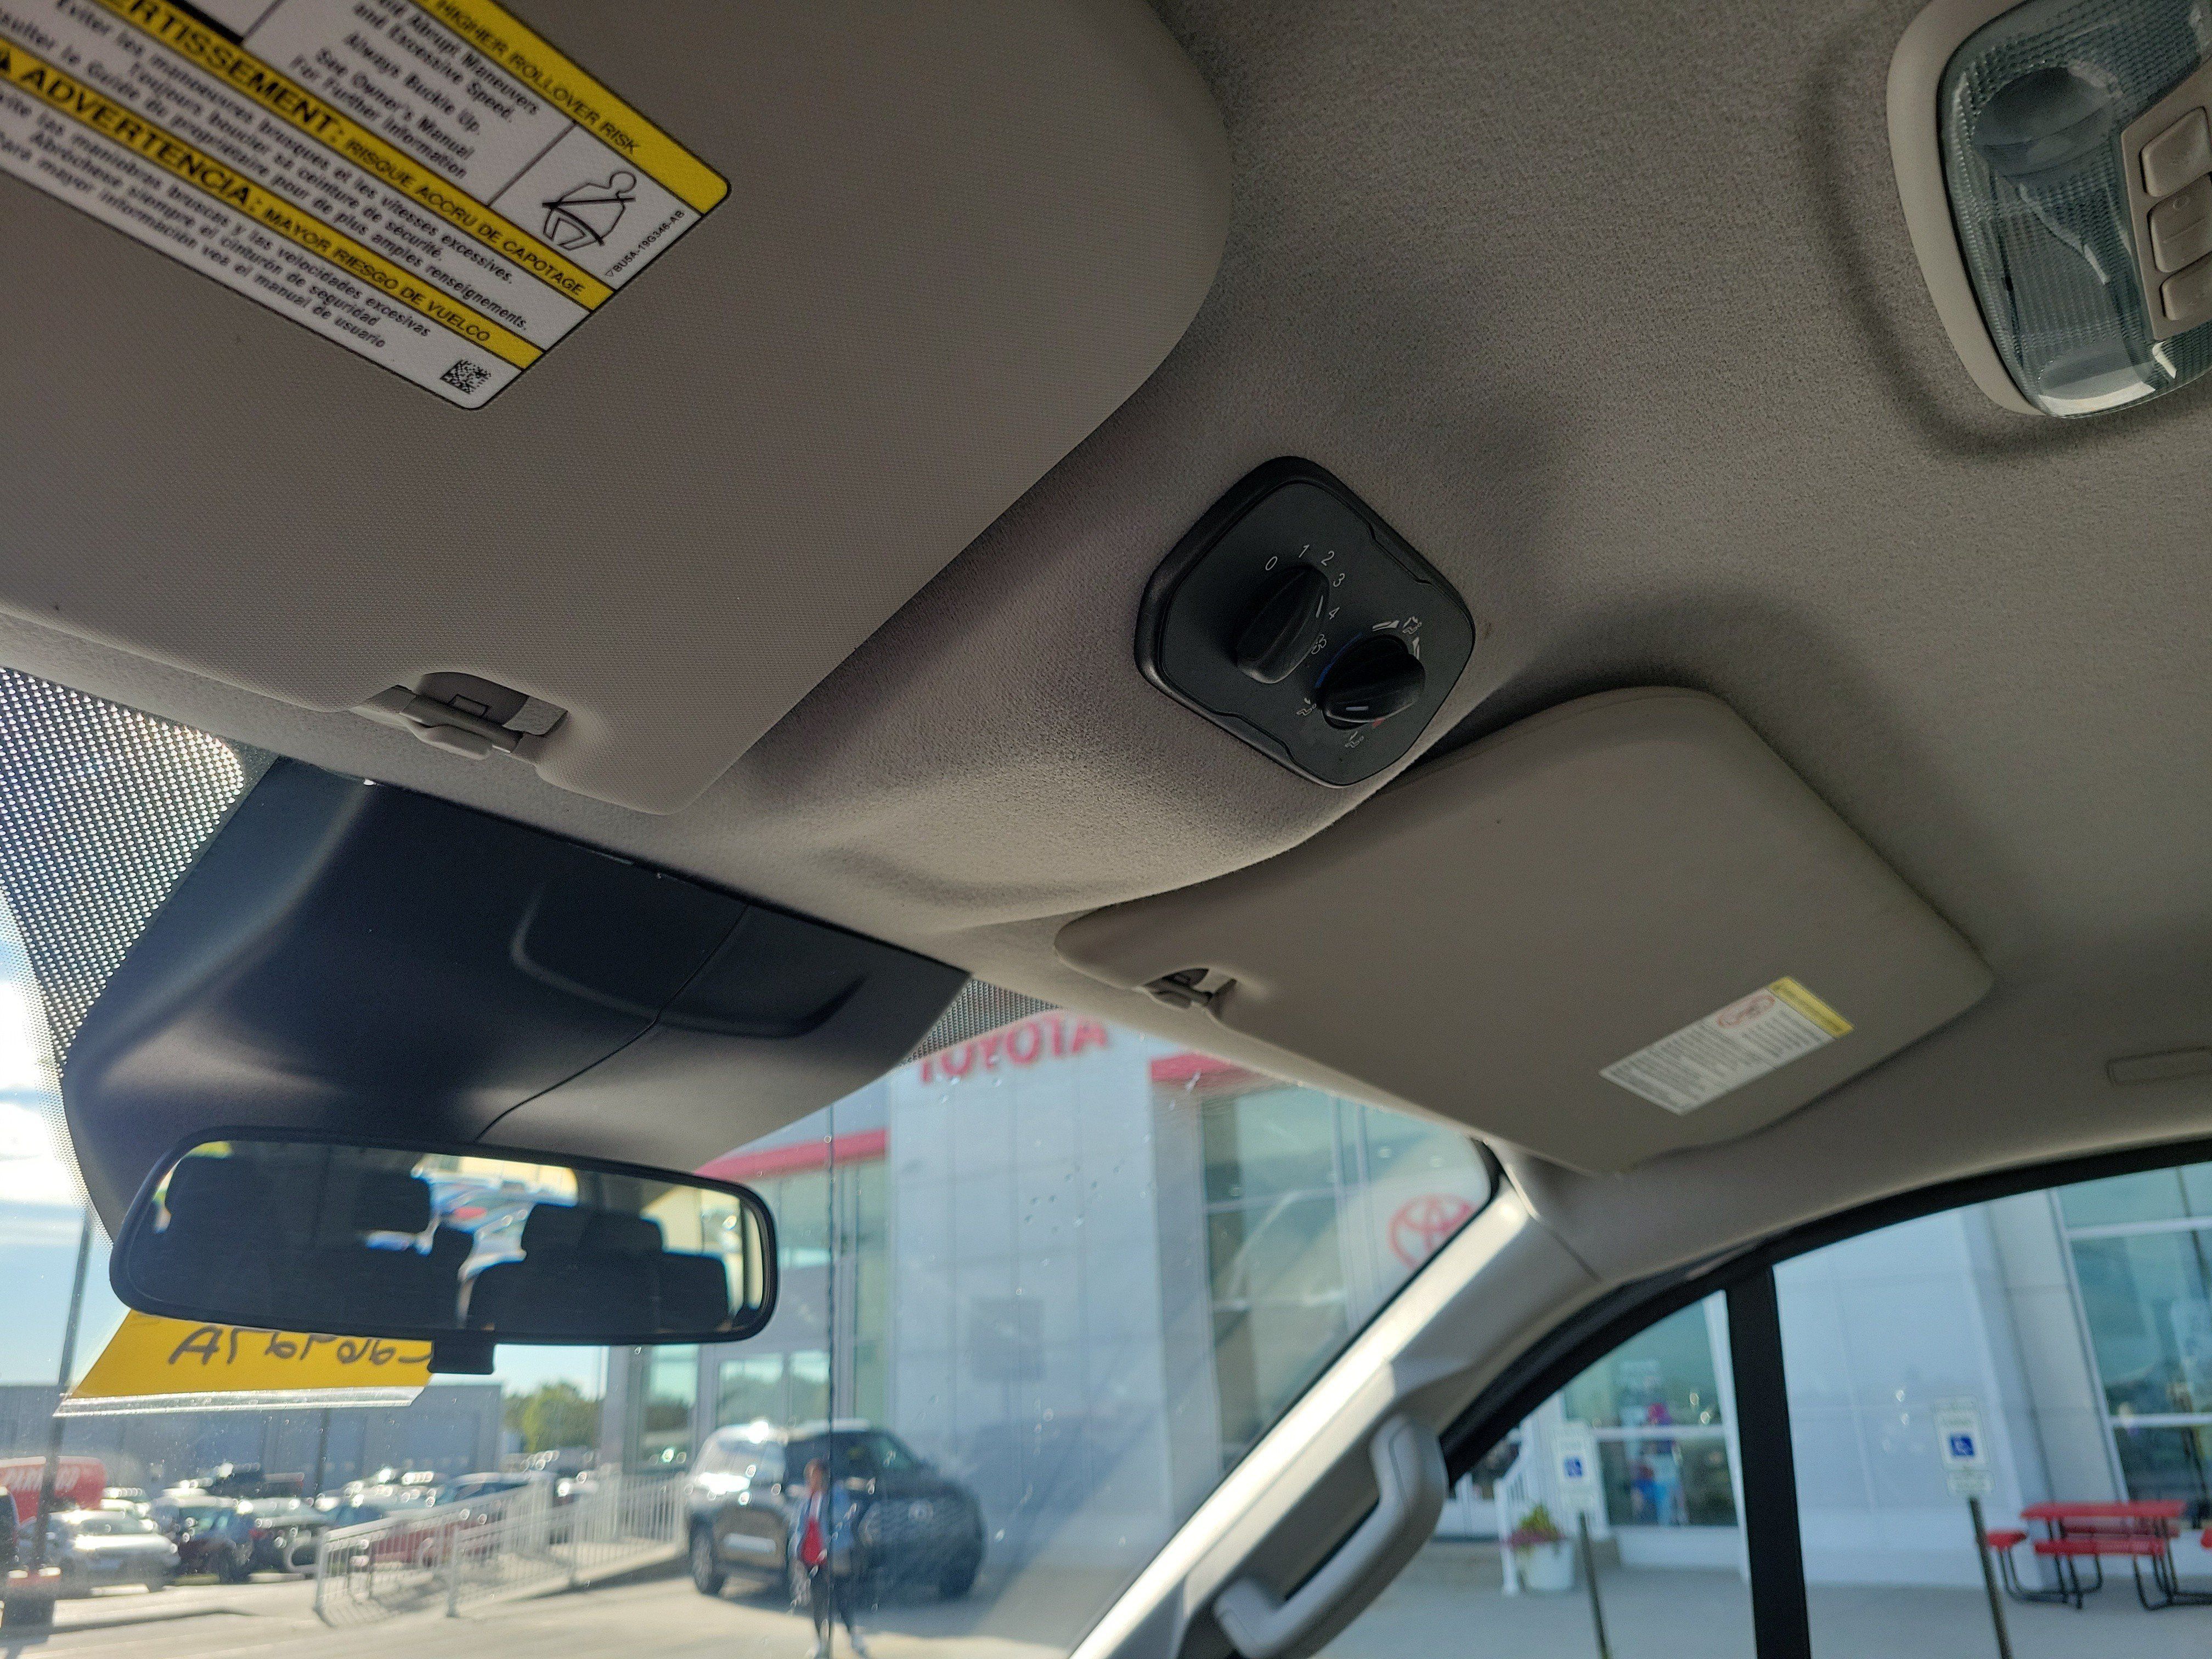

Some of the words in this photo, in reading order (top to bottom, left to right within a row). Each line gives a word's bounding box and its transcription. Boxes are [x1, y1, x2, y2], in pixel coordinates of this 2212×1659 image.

[314, 48, 351, 76] See
[416, 116, 475, 159] Manual
[342, 31, 405, 80] Always
[403, 73, 459, 115] Buckle
[454, 110, 487, 136] Up.
[353, 0, 388, 29] and
[464, 82, 519, 123] Speed.
[408, 15, 462, 58] Abrupt
[460, 52, 543, 115] Maneuvers
[509, 53, 601, 124] ROLLOVER
[599, 122, 640, 154] RISK
[115, 31, 148, 56] les
[253, 118, 335, 174] brusques
[332, 166, 353, 182] et
[353, 178, 380, 198] les
[379, 195, 442, 236] vitesses
[441, 233, 518, 284] excessives.
[290, 55, 324, 82] For
[321, 76, 383, 121] Further
[381, 117, 470, 179] Information
[34, 159, 93, 195] mayor
[235, 263, 253, 276] el
[254, 273, 312, 308] manual
[312, 304, 334, 319] de
[335, 316, 388, 348] usuario
[36, 112, 69, 135] las
[247, 229, 276, 249] las
[277, 246, 366, 299] velocidades
[365, 296, 433, 336] excesivas
[269, 174, 308, 200] pour
[314, 197, 336, 213] de
[335, 211, 371, 236] plus
[370, 232, 425, 268] amples
[424, 264, 532, 331] renseignements.
[298, 166, 363, 208] ceinture
[363, 206, 385, 222] de
[386, 219, 449, 261] sécurité.
[343, 138, 416, 188] RISQUE
[415, 184, 477, 226] ACCRU
[476, 224, 503, 242] DE
[501, 239, 586, 295] CAPOTAGE
[198, 223, 219, 239] el
[286, 272, 308, 287] de
[307, 283, 381, 328] seguridad
[263, 208, 332, 251] MAYOR
[333, 249, 399, 290] RIESGO
[399, 287, 425, 304] DE
[425, 302, 491, 342] VUELCO
[1265, 556, 1278, 571] 0
[1299, 544, 1310, 558] 1
[1321, 550, 1334, 566] 2
[1333, 573, 1345, 587] 3
[1329, 607, 1340, 620] 4
